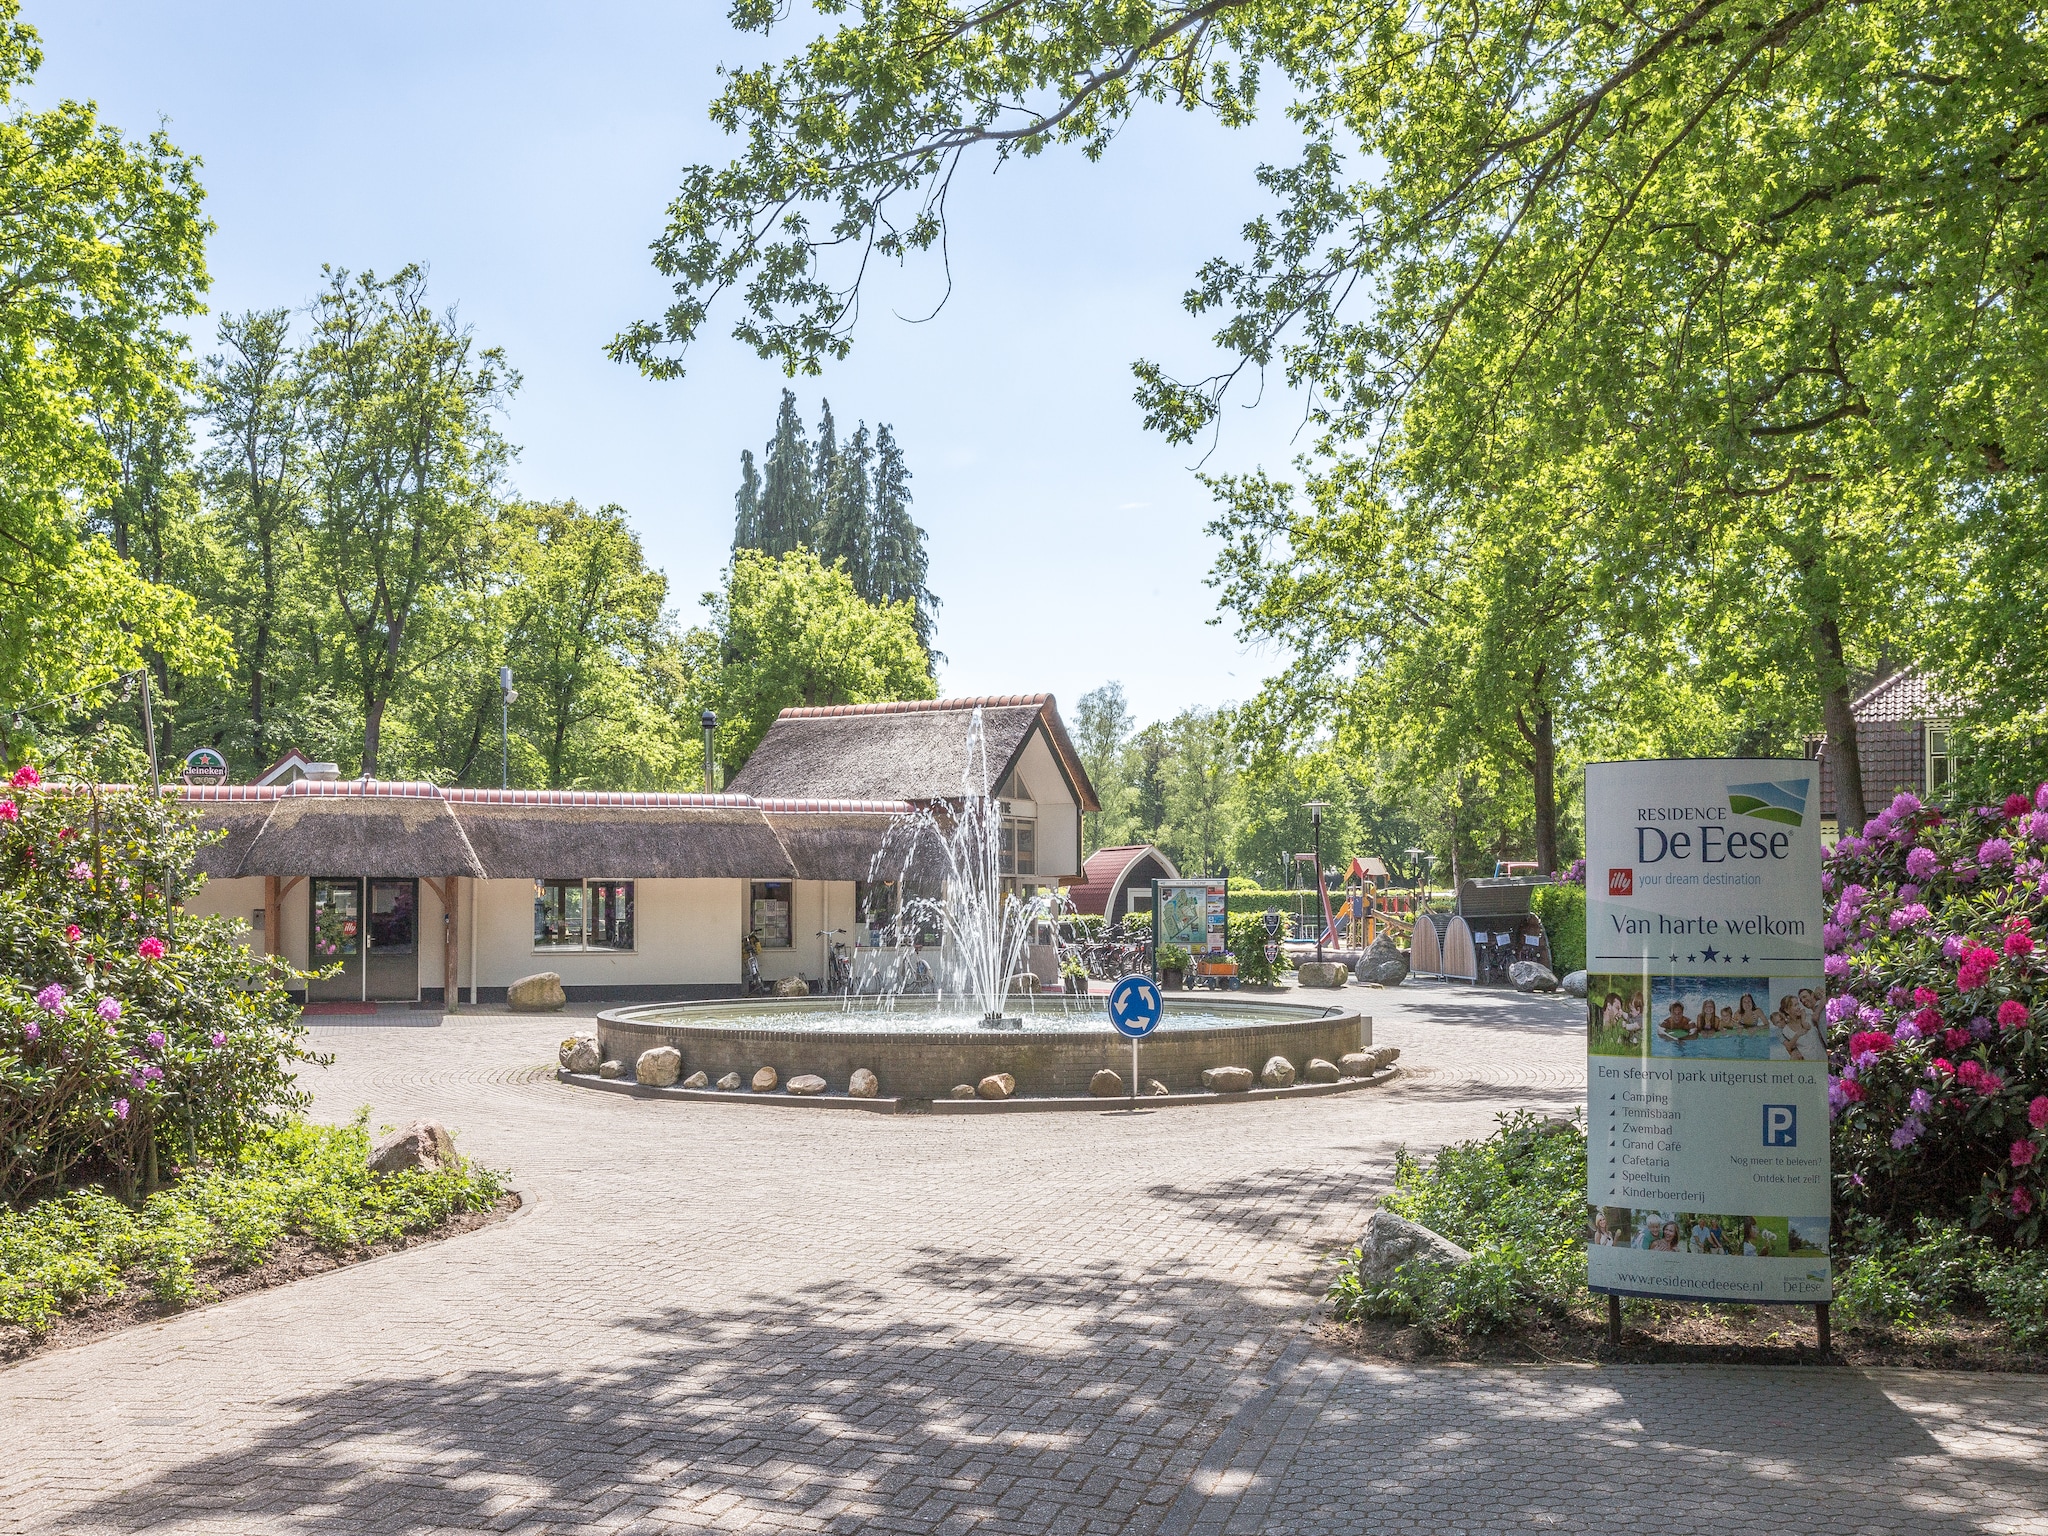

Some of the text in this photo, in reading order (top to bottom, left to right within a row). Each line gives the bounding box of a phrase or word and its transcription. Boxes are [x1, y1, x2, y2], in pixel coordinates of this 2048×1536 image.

[1637, 807, 1727, 821] RESIDENCE
[1634, 826, 1691, 863] De
[1610, 872, 1631, 892] illy
[1639, 872, 1761, 888] your dream destination
[344, 922, 356, 933] illy
[1610, 914, 1805, 936] Van harte welkom
[1598, 1065, 1817, 1086] Een sfeervol park uitgerust met o.a.
[1622, 1090, 1668, 1105] Camping
[1622, 1106, 1681, 1120] Tennisbaan
[1622, 1122, 1673, 1135] Zwembad
[1767, 1107, 1793, 1144] P
[1622, 1138, 1682, 1152] Grand Café
[1622, 1154, 1670, 1167] Cafetaria
[1730, 1155, 1822, 1167] Nog meer te beleven?
[1622, 1170, 1670, 1183] Speeltuin
[1752, 1173, 1821, 1184] Ontdek het zelf!
[1622, 1186, 1705, 1203] Kinderboerderij
[1617, 1272, 1763, 1292] www.residencedeeese.nl
[1783, 1281, 1798, 1293] De
